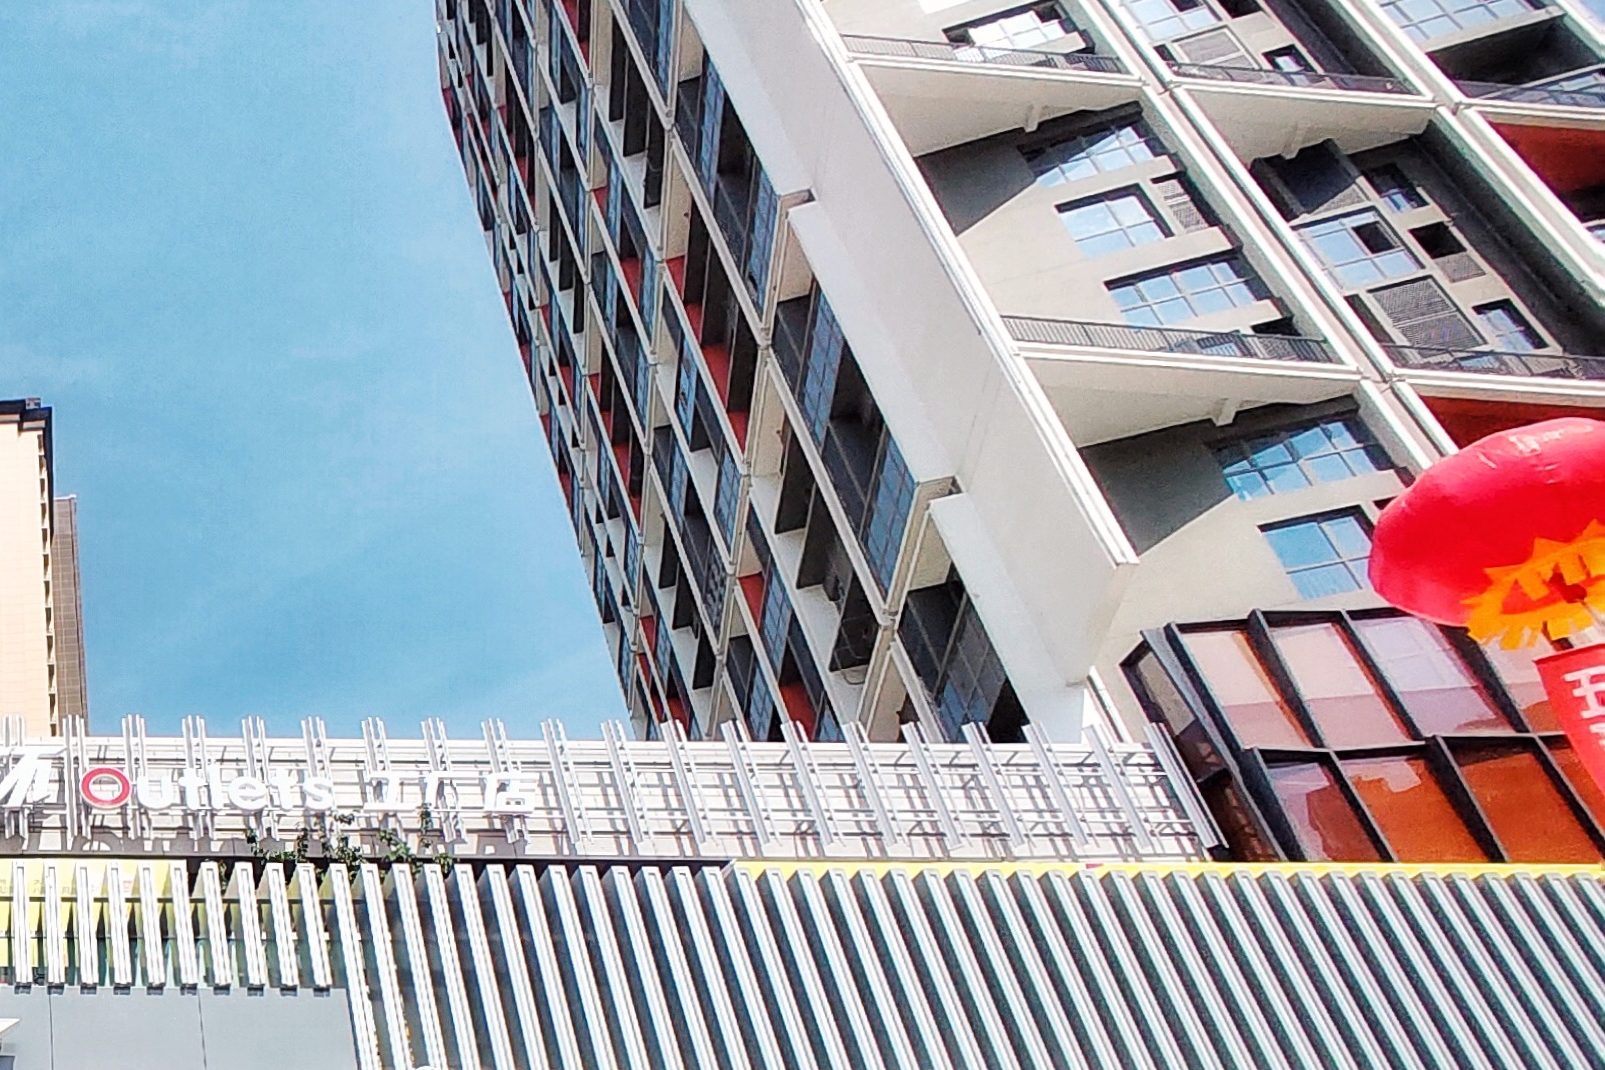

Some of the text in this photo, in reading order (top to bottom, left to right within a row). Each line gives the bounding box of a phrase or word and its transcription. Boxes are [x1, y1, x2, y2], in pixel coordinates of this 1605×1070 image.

[80, 761, 334, 812] Outlets
[363, 763, 537, 814] 工厂店
